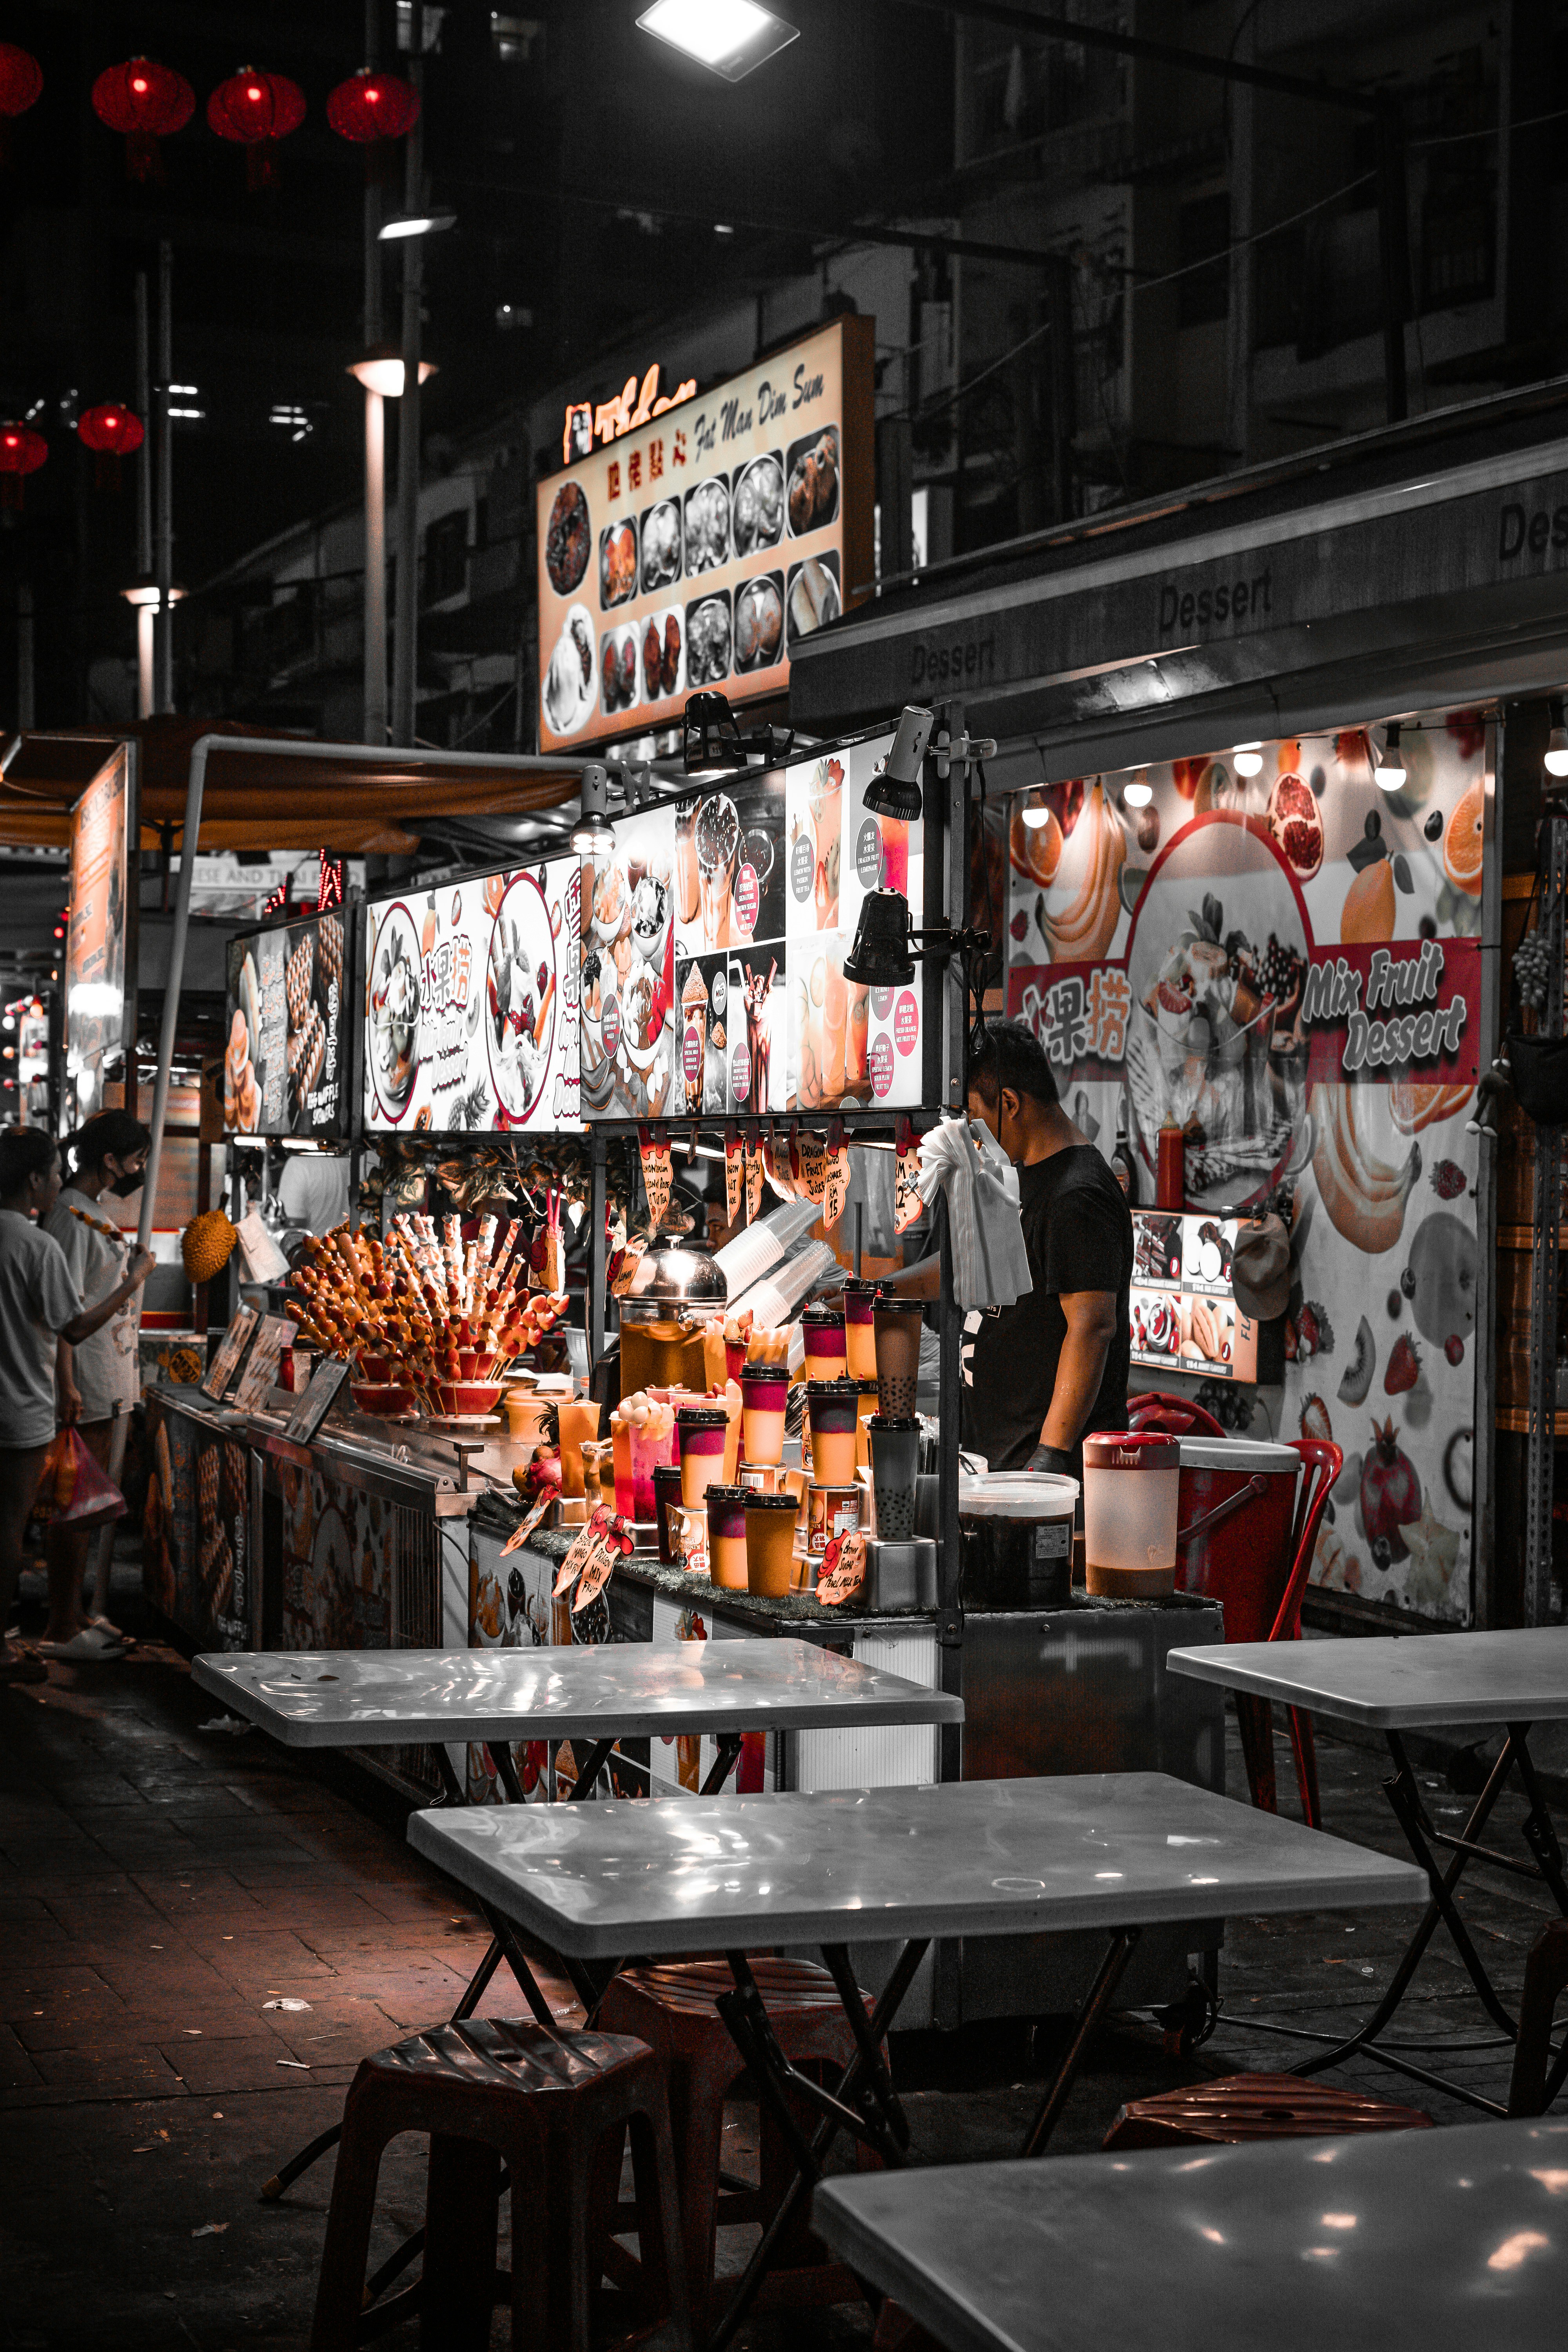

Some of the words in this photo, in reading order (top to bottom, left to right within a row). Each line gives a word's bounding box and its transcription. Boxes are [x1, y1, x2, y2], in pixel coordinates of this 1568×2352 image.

[695, 414, 715, 462] Fat
[721, 399, 753, 441] Man
[759, 382, 787, 425] Dim
[793, 364, 824, 410] Sum
[1160, 568, 1272, 633] Dessert
[912, 634, 995, 683] Dessert
[863, 843, 875, 854] 水果茶
[797, 856, 808, 866] 水果茶
[858, 855, 871, 864] DRAGON
[871, 853, 879, 862] FRUIT
[860, 864, 877, 873] LEMONADE
[797, 876, 808, 884] PASSION
[739, 893, 754, 902] SIGNATURE
[746, 902, 757, 911] SUGAR
[1302, 958, 1361, 1022] Mix
[1366, 939, 1444, 1009] Fruit
[716, 988, 724, 997] MILO
[901, 1015, 912, 1024] 水果茶
[1342, 994, 1467, 1071] Dessert
[432, 1043, 468, 1089] Dessert
[877, 1055, 888, 1064] 水果茶
[802, 1144, 824, 1158] DRAGON
[728, 1165, 739, 1175] RAGON
[829, 1186, 838, 1200] RM
[829, 1198, 838, 1220] 15
[572, 1547, 587, 1559] MANGO
[594, 1548, 614, 1568] DRAGON
[563, 1560, 574, 1571] MIX
[589, 1564, 603, 1583] MIX
[839, 1574, 853, 1588] MILK
[581, 1580, 598, 1597] FRUIT
